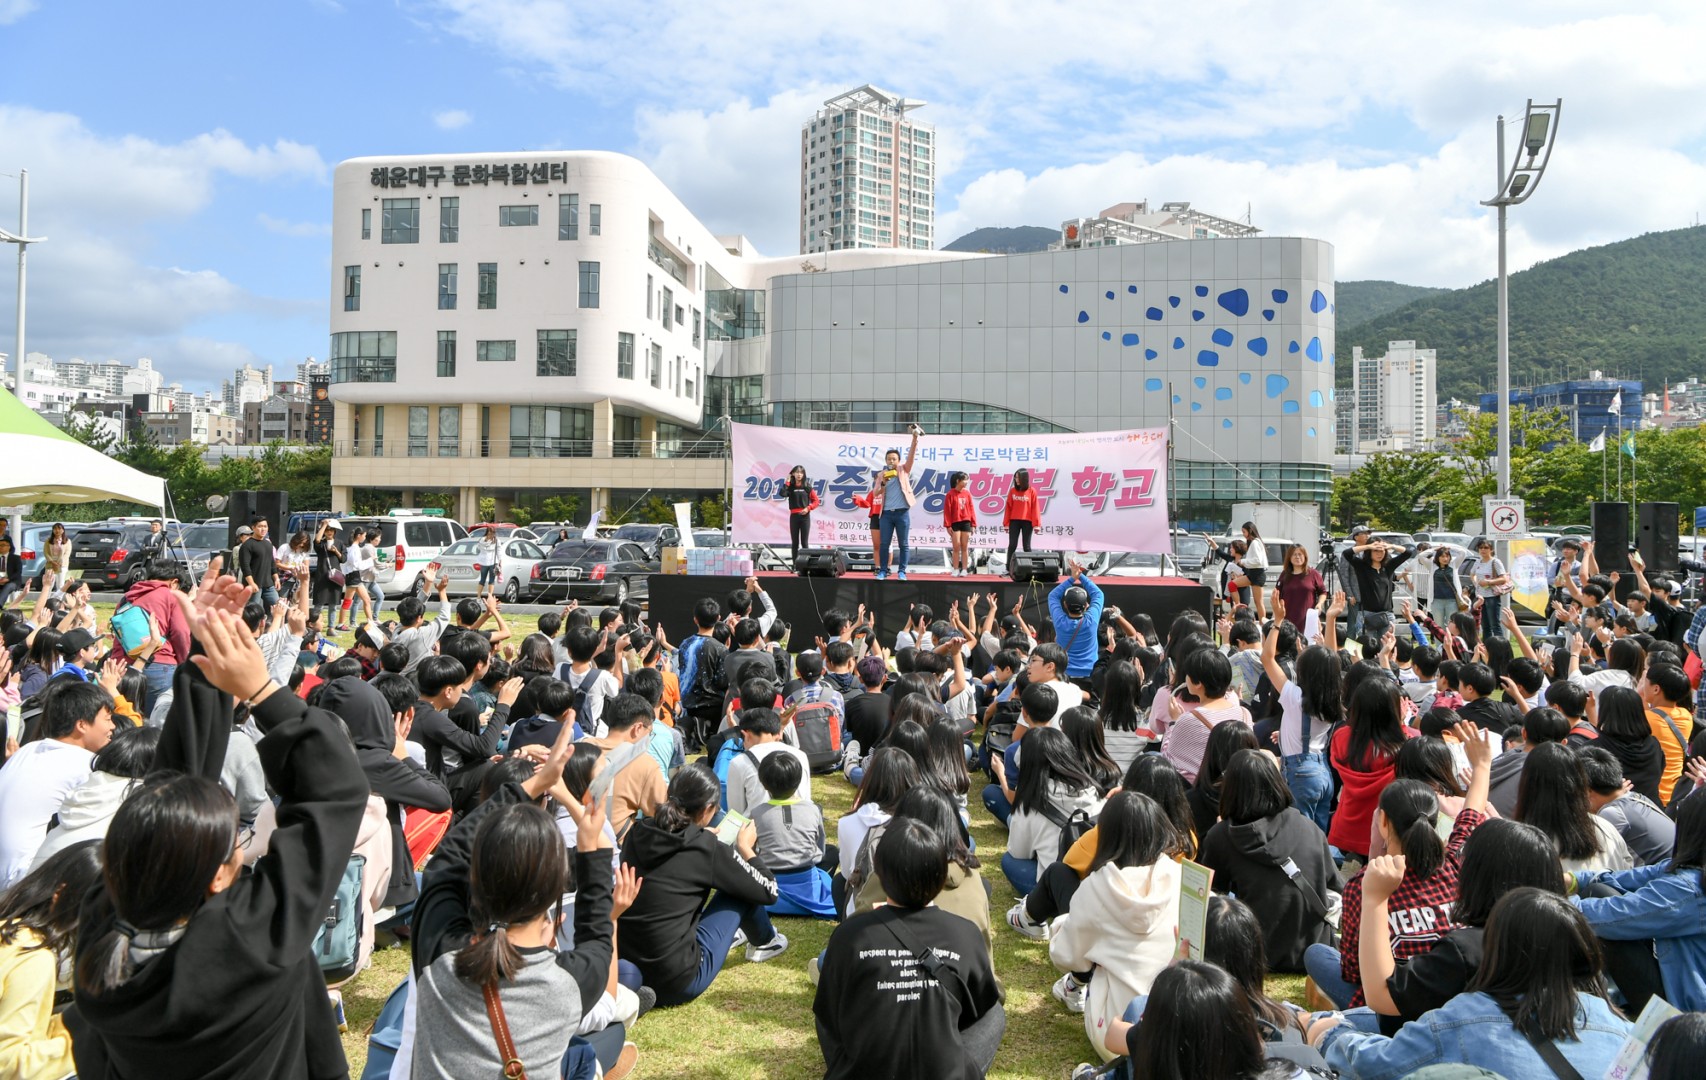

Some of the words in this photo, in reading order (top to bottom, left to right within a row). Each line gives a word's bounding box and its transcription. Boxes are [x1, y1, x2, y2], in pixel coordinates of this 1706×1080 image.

[370, 165, 446, 189] 해운대구
[452, 161, 568, 187] 문화복합센터
[837, 444, 879, 459] 2017
[963, 446, 1049, 462] 진로박람회
[828, 464, 956, 515] 중생
[1071, 465, 1156, 513] 학교
[816, 519, 836, 531] 일시
[838, 521, 870, 531] 2017.9.2
[926, 524, 945, 534] 장소
[839, 533, 873, 543] 해운대
